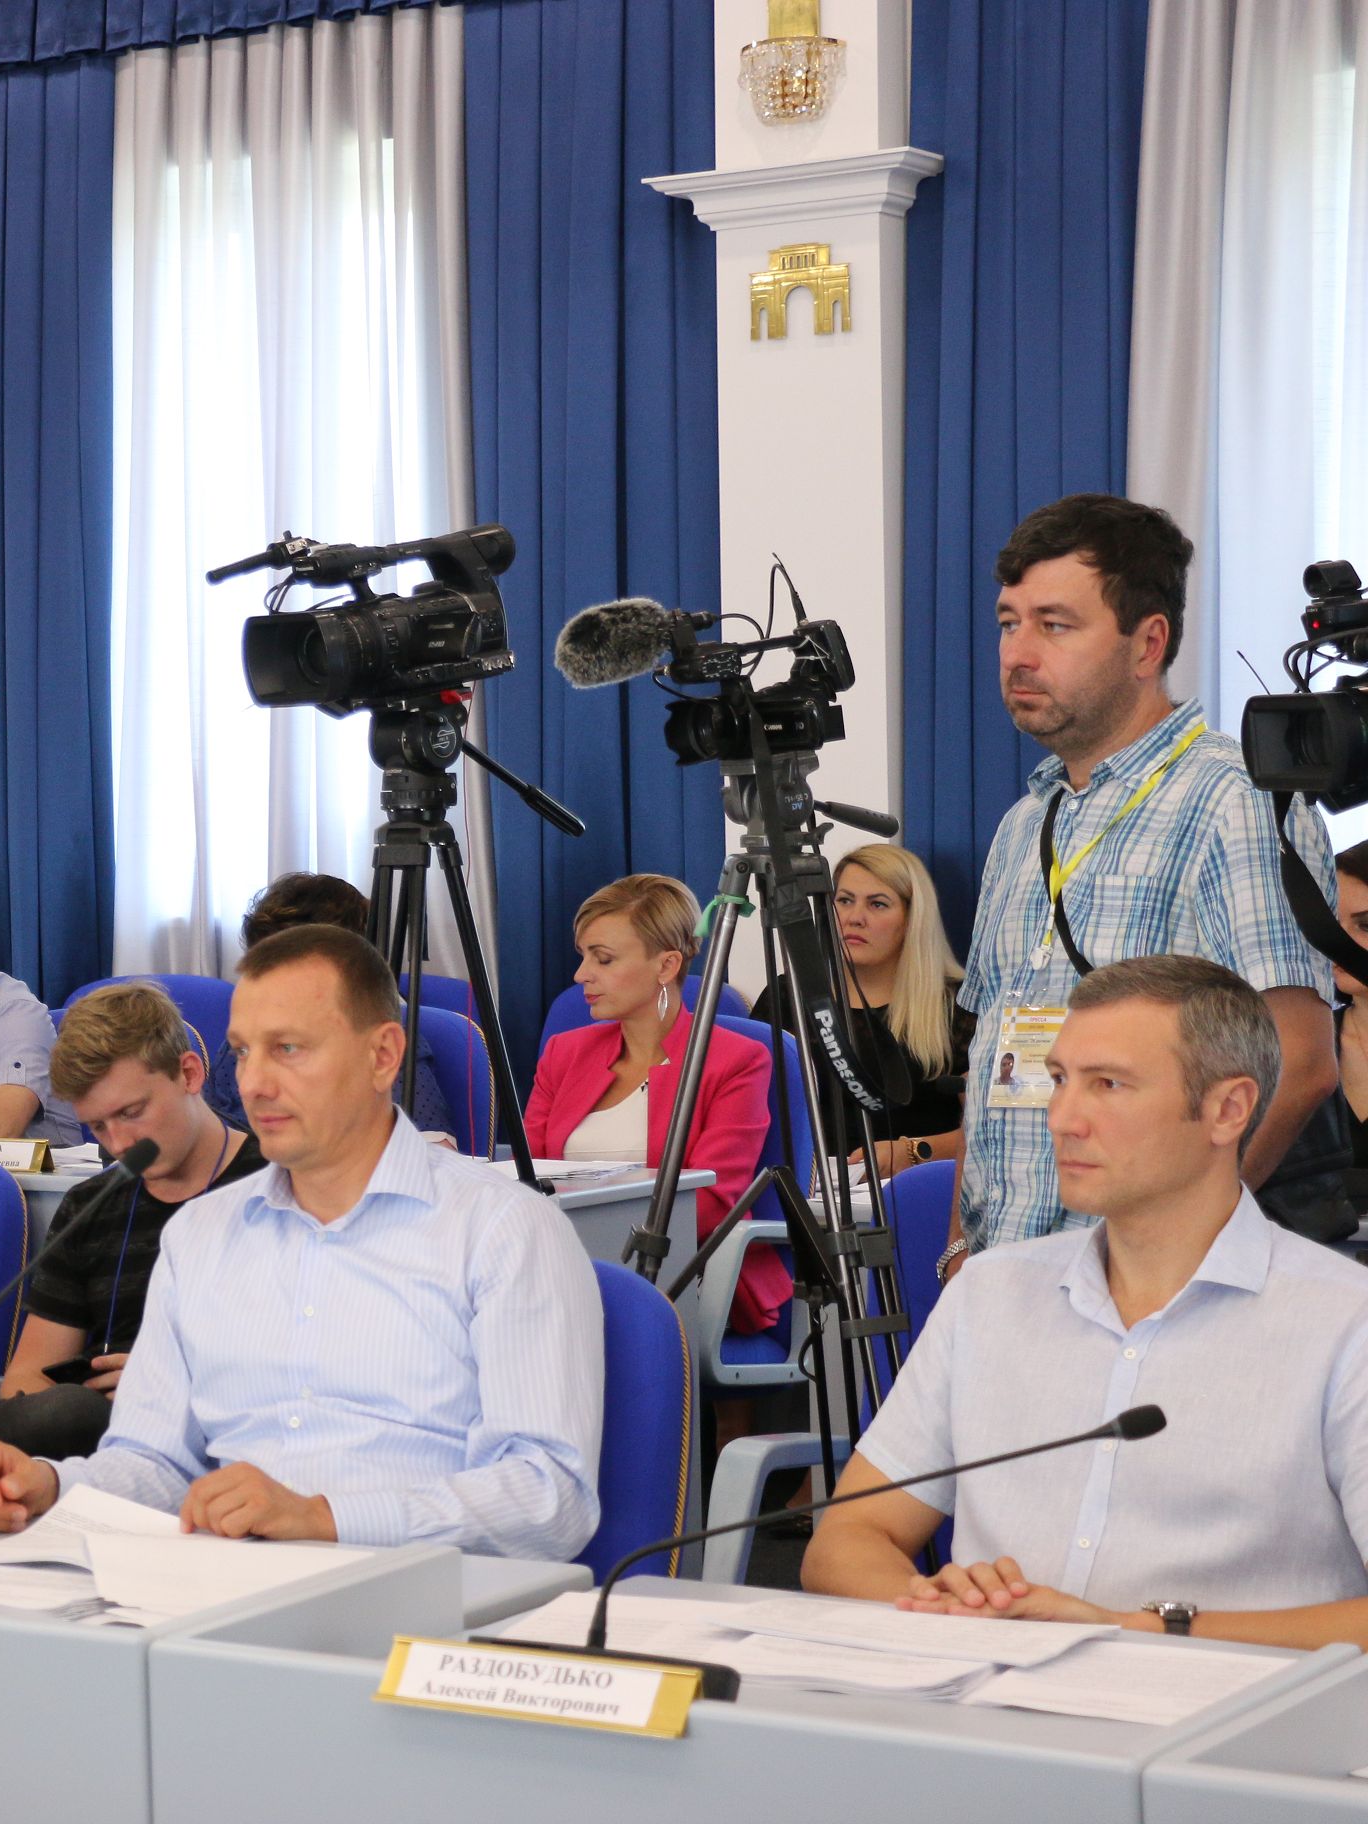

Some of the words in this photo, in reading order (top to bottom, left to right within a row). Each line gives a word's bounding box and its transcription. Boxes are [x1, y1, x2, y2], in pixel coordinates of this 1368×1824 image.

[814, 1009, 884, 1111] Panasonic
[438, 1653, 614, 1690] РАЗДОБУДЬКО
[420, 1679, 497, 1702] Алексей
[502, 1686, 621, 1716] Викторович
